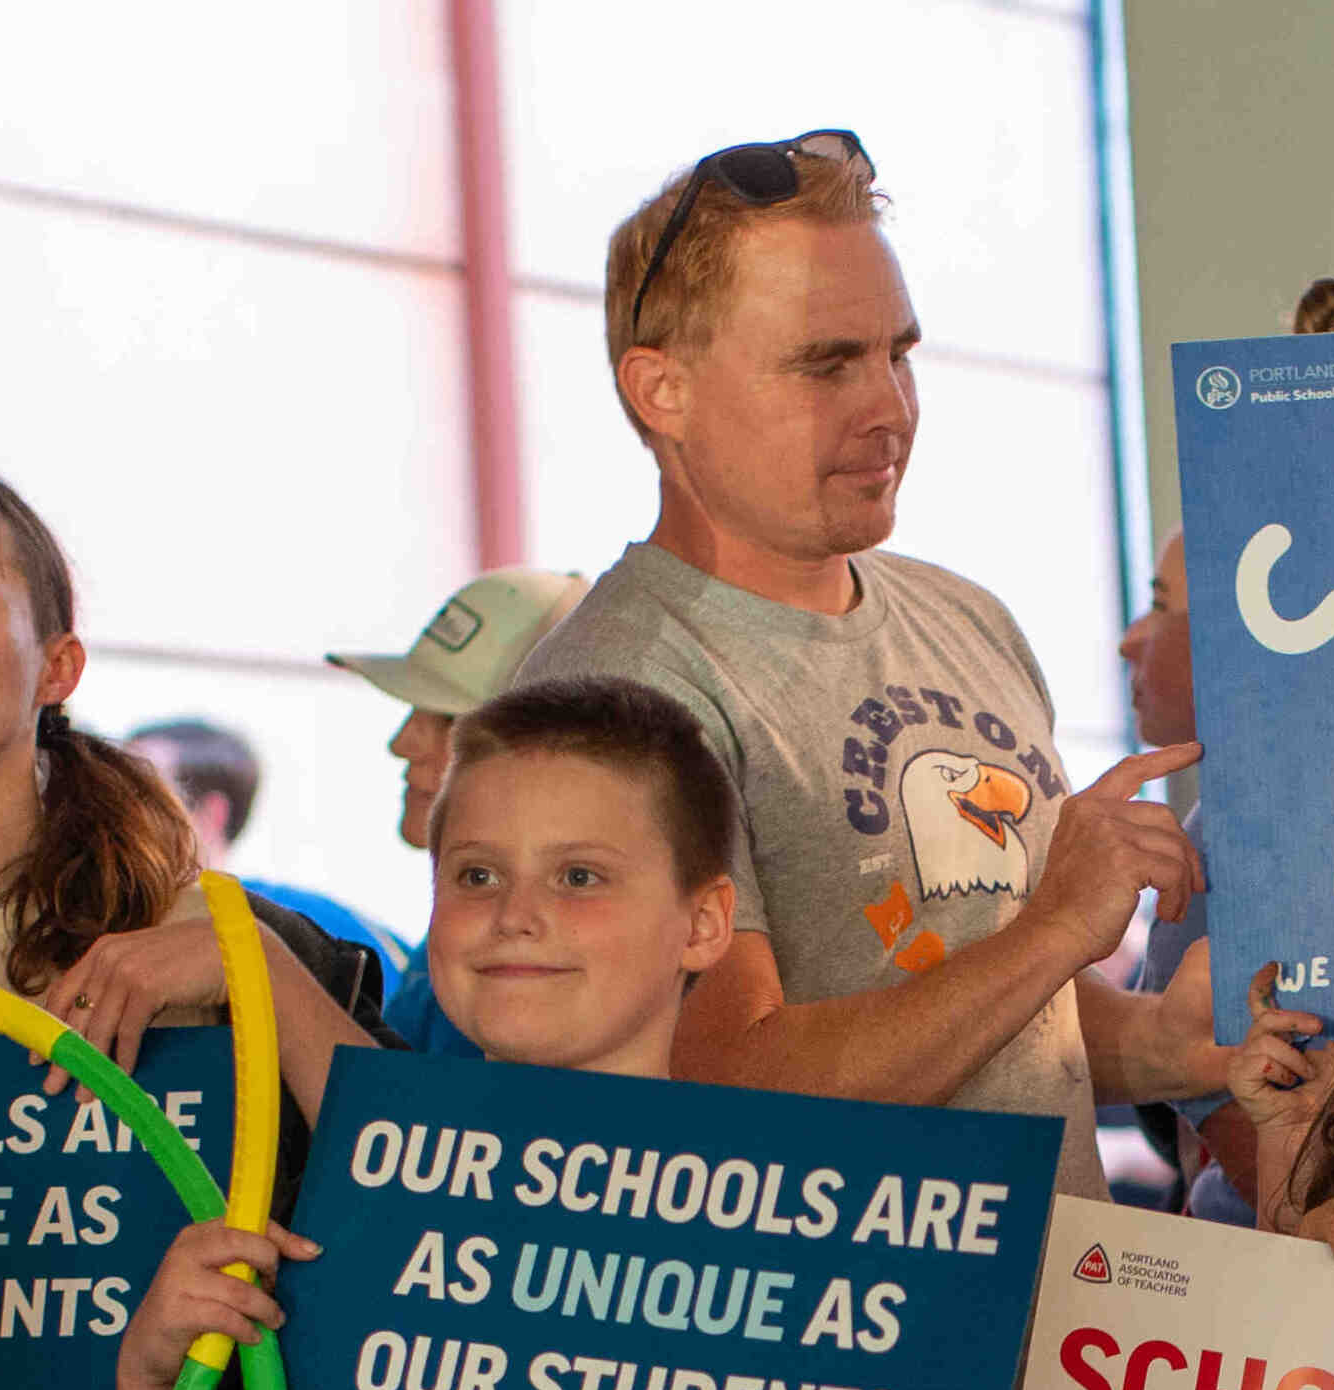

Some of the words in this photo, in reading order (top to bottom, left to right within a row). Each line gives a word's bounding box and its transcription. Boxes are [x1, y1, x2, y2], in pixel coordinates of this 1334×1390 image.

[1250, 391, 1292, 404] Public
[842, 685, 1069, 837] CRESTON
[1275, 957, 1330, 993] WE
[350, 1119, 503, 1201] OUR
[514, 1137, 845, 1240] SCHOOLS
[851, 1175, 1010, 1256] ARE
[27, 1185, 122, 1246] AS
[1119, 1264, 1191, 1285] ASSOCIATION
[1122, 1251, 1180, 1270] PORTLAND
[392, 1231, 499, 1307] AS
[510, 1242, 796, 1344] UNIQUE
[800, 1278, 908, 1354] AS
[1117, 1276, 1132, 1287] OF
[1134, 1279, 1188, 1297] TEACHERS
